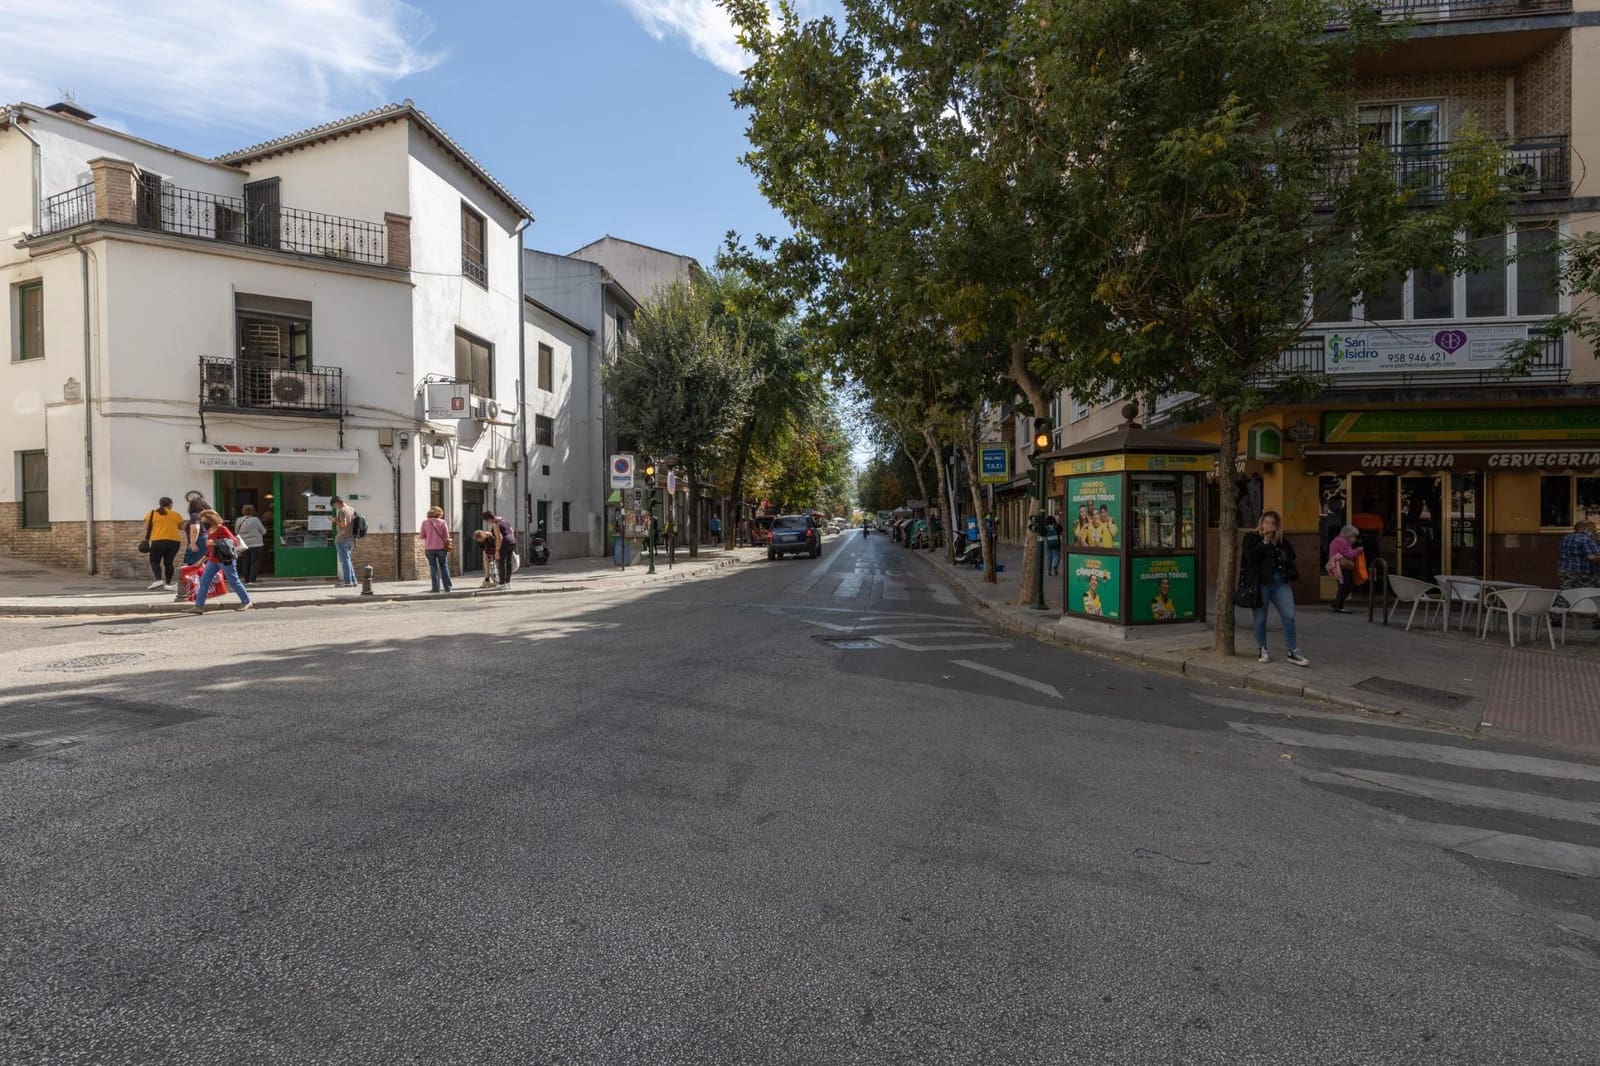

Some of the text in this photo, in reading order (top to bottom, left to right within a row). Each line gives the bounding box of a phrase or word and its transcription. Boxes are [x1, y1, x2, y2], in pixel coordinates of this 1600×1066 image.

[1344, 337, 1365, 347] San
[1345, 348, 1378, 359] Isidro
[1388, 352, 1446, 363] 958 946 421
[1097, 494, 1115, 502] TODOS
